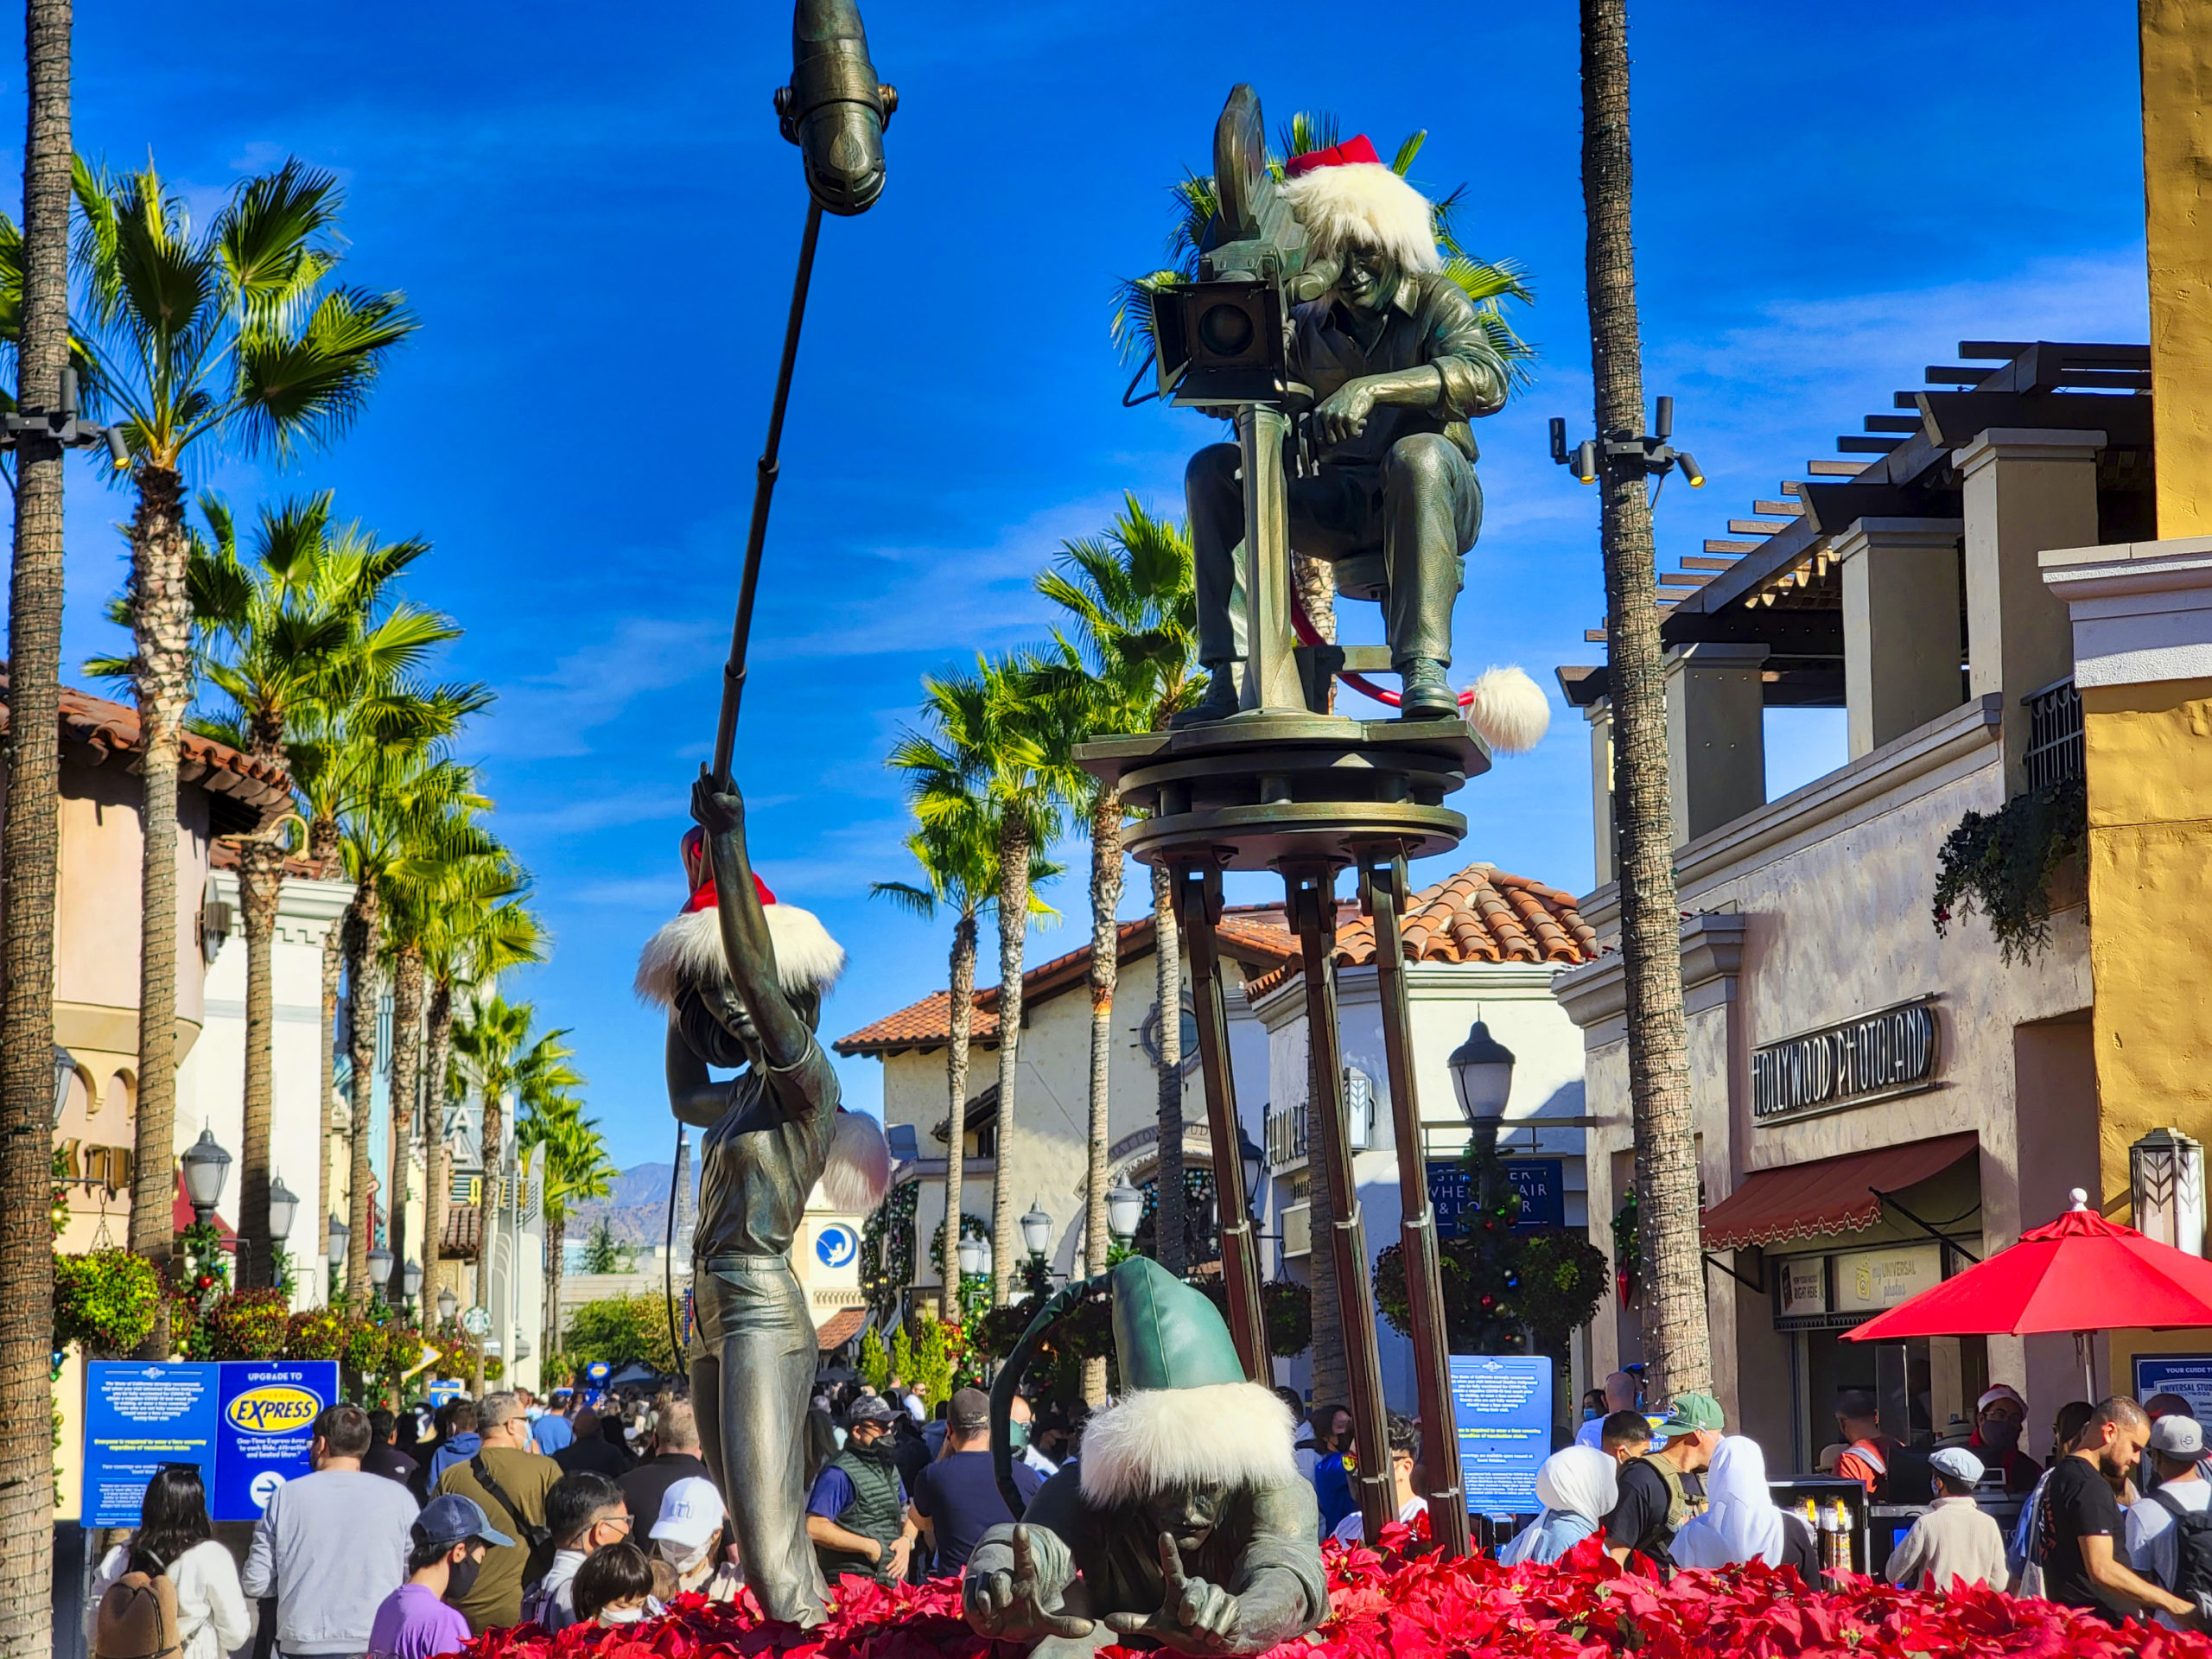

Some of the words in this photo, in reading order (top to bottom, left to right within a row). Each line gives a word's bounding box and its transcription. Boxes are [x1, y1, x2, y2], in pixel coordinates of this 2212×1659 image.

[1751, 1036, 1836, 1116] HOLLYWOOD
[1837, 1007, 1927, 1096] PHOTOLAND
[1882, 1258, 1916, 1279] UNIVERSAL
[1794, 1287, 1806, 1300] RIGHT
[1807, 1286, 1818, 1299] HERE
[1884, 1281, 1907, 1304] photos
[248, 1373, 289, 1382] UPGRADE
[290, 1372, 302, 1381] TO
[236, 1400, 312, 1427] EXPRESS
